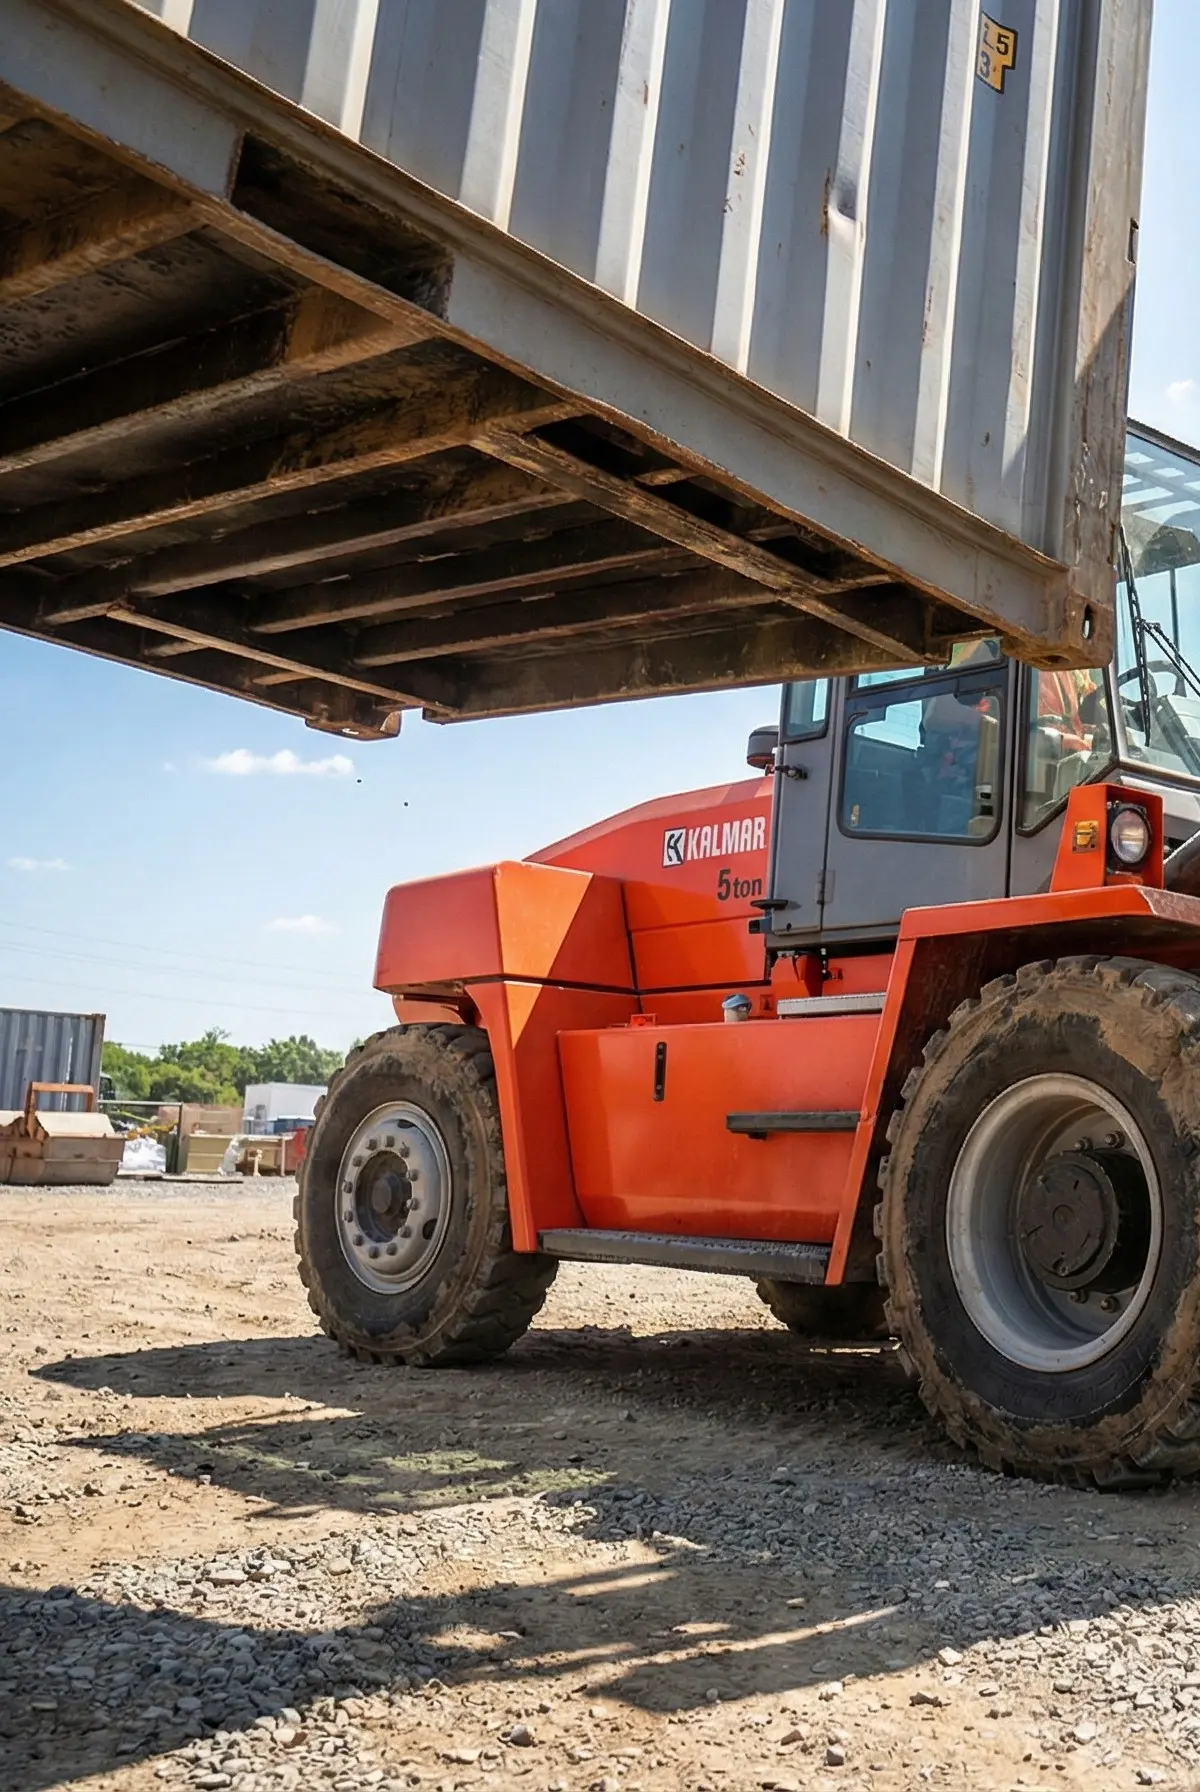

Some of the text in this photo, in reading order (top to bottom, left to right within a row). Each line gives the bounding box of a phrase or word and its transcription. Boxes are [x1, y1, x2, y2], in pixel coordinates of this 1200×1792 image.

[687, 816, 766, 861] KALMAR
[717, 868, 762, 901] 5 ton
